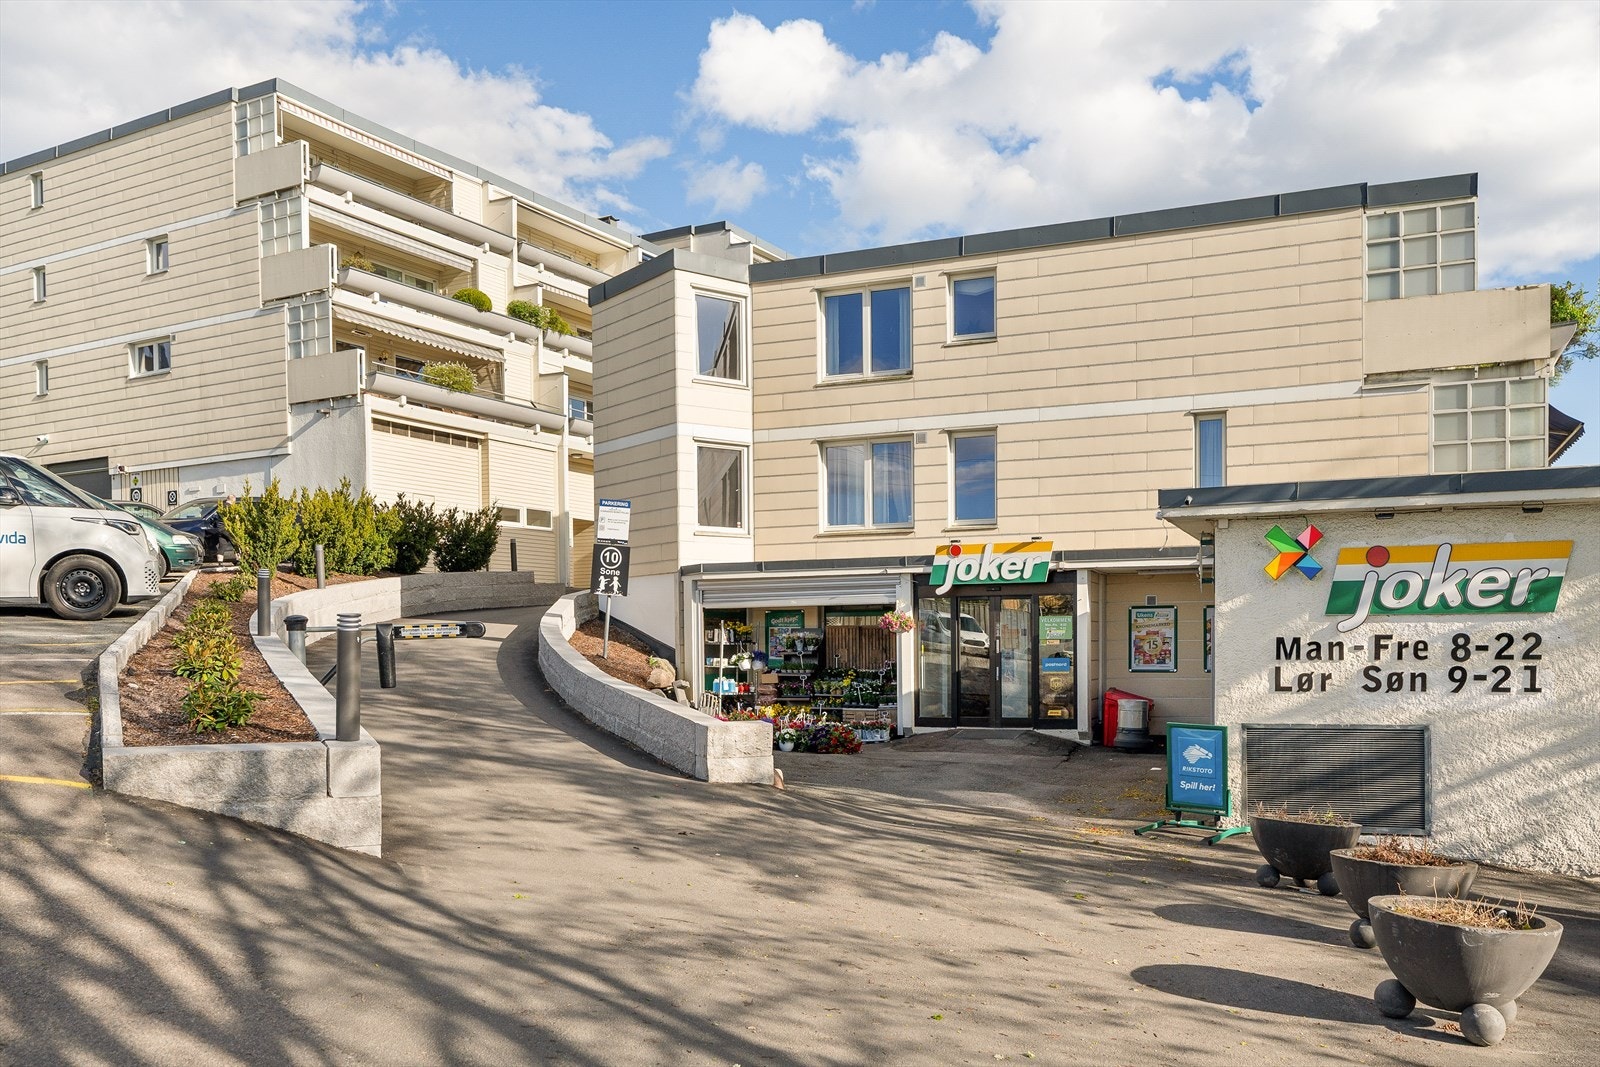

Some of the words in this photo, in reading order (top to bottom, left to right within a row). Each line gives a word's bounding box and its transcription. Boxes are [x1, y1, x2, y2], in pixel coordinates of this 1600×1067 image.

[604, 552, 618, 563] 10
[600, 567, 621, 576] Sone
[935, 543, 1043, 596] joker
[1336, 542, 1551, 634] joker
[1146, 640, 1158, 649] 15
[1451, 633, 1543, 662] 8-22
[1274, 666, 1333, 693] Lør
[1361, 665, 1428, 694] Søn
[1448, 665, 1543, 694] 9-21
[1182, 766, 1213, 774] RIKSTOTO
[1180, 781, 1198, 790] Spill
[1199, 783, 1216, 791] her!
